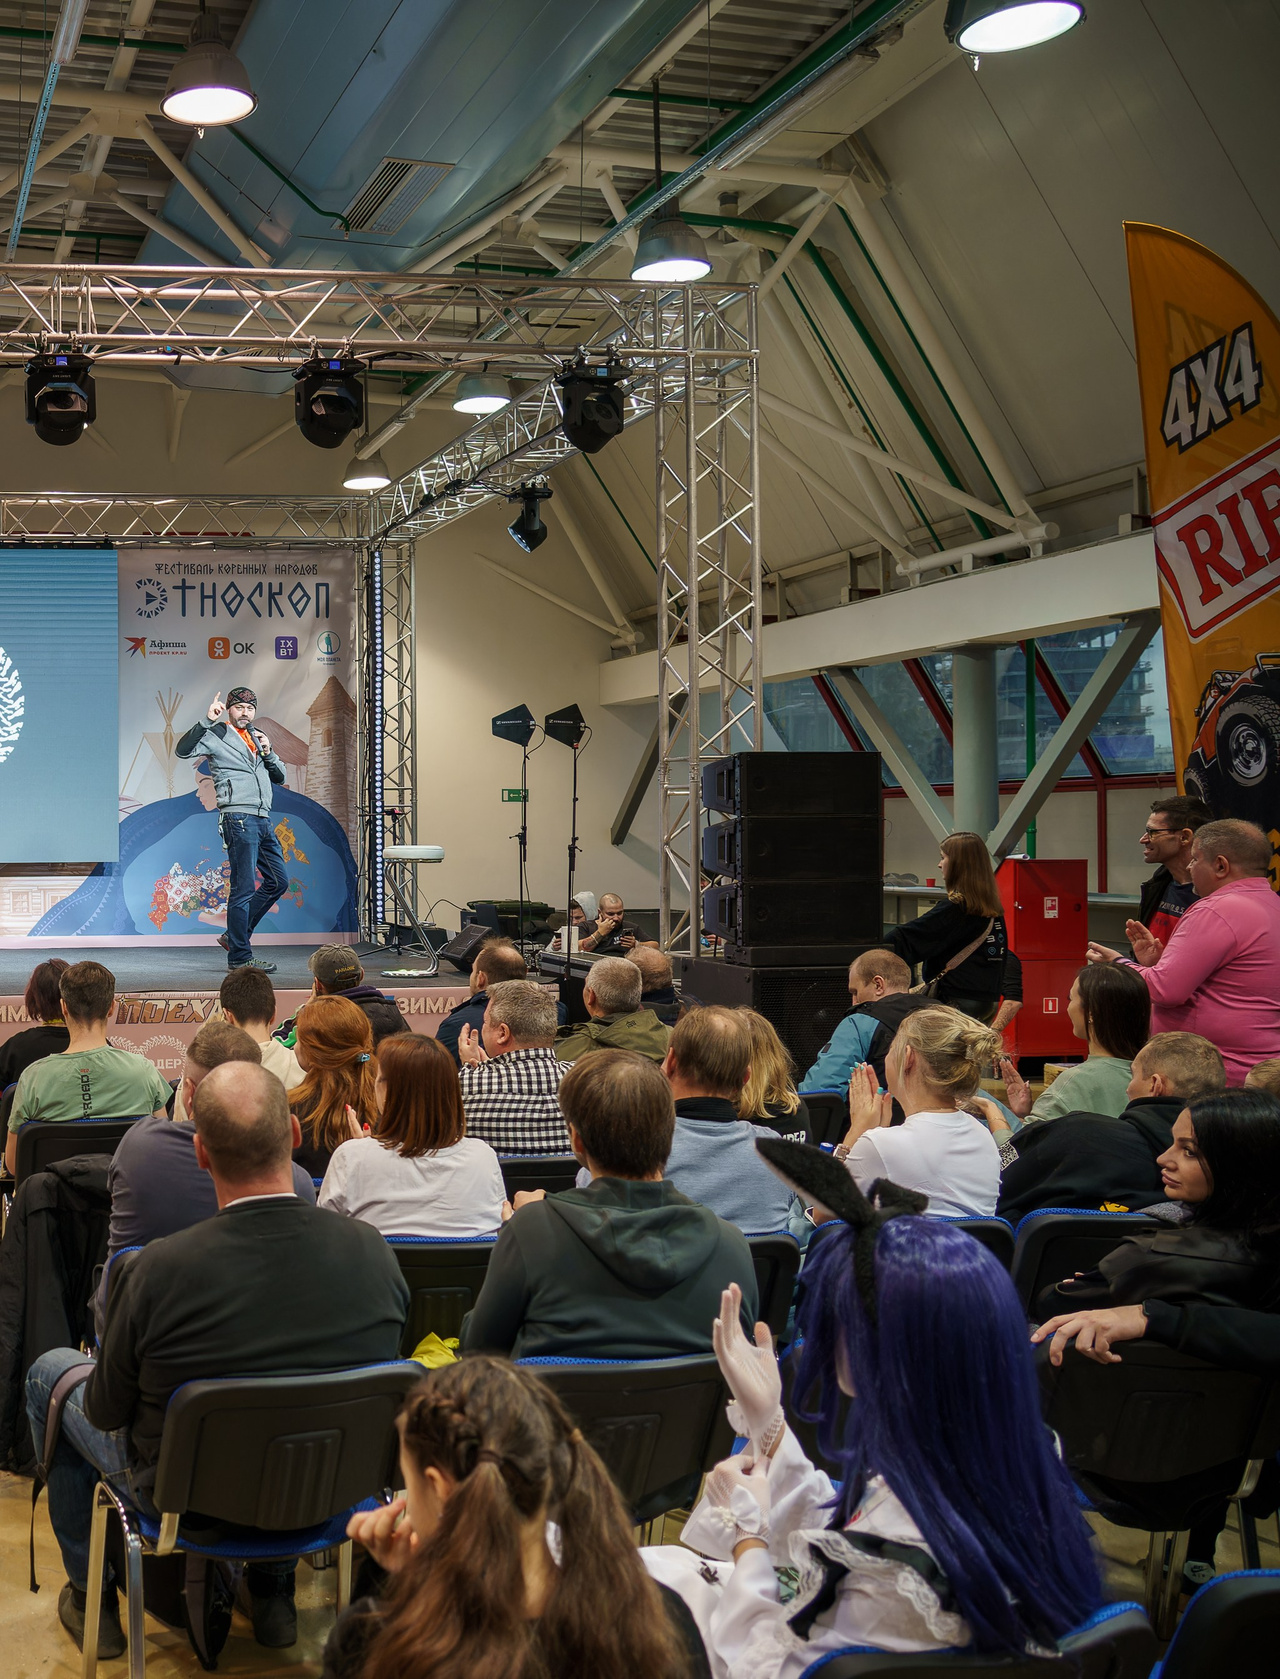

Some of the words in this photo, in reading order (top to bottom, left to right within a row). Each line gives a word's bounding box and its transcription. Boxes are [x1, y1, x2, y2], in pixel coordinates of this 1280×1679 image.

[1163, 323, 1261, 450] 4X4
[155, 562, 214, 575] ФЕСТИВАЛЬ
[218, 563, 267, 575] КОРЕННЫХ
[275, 564, 317, 575] НАРОДОВ
[149, 639, 187, 650] Афиша
[280, 639, 293, 647] IX
